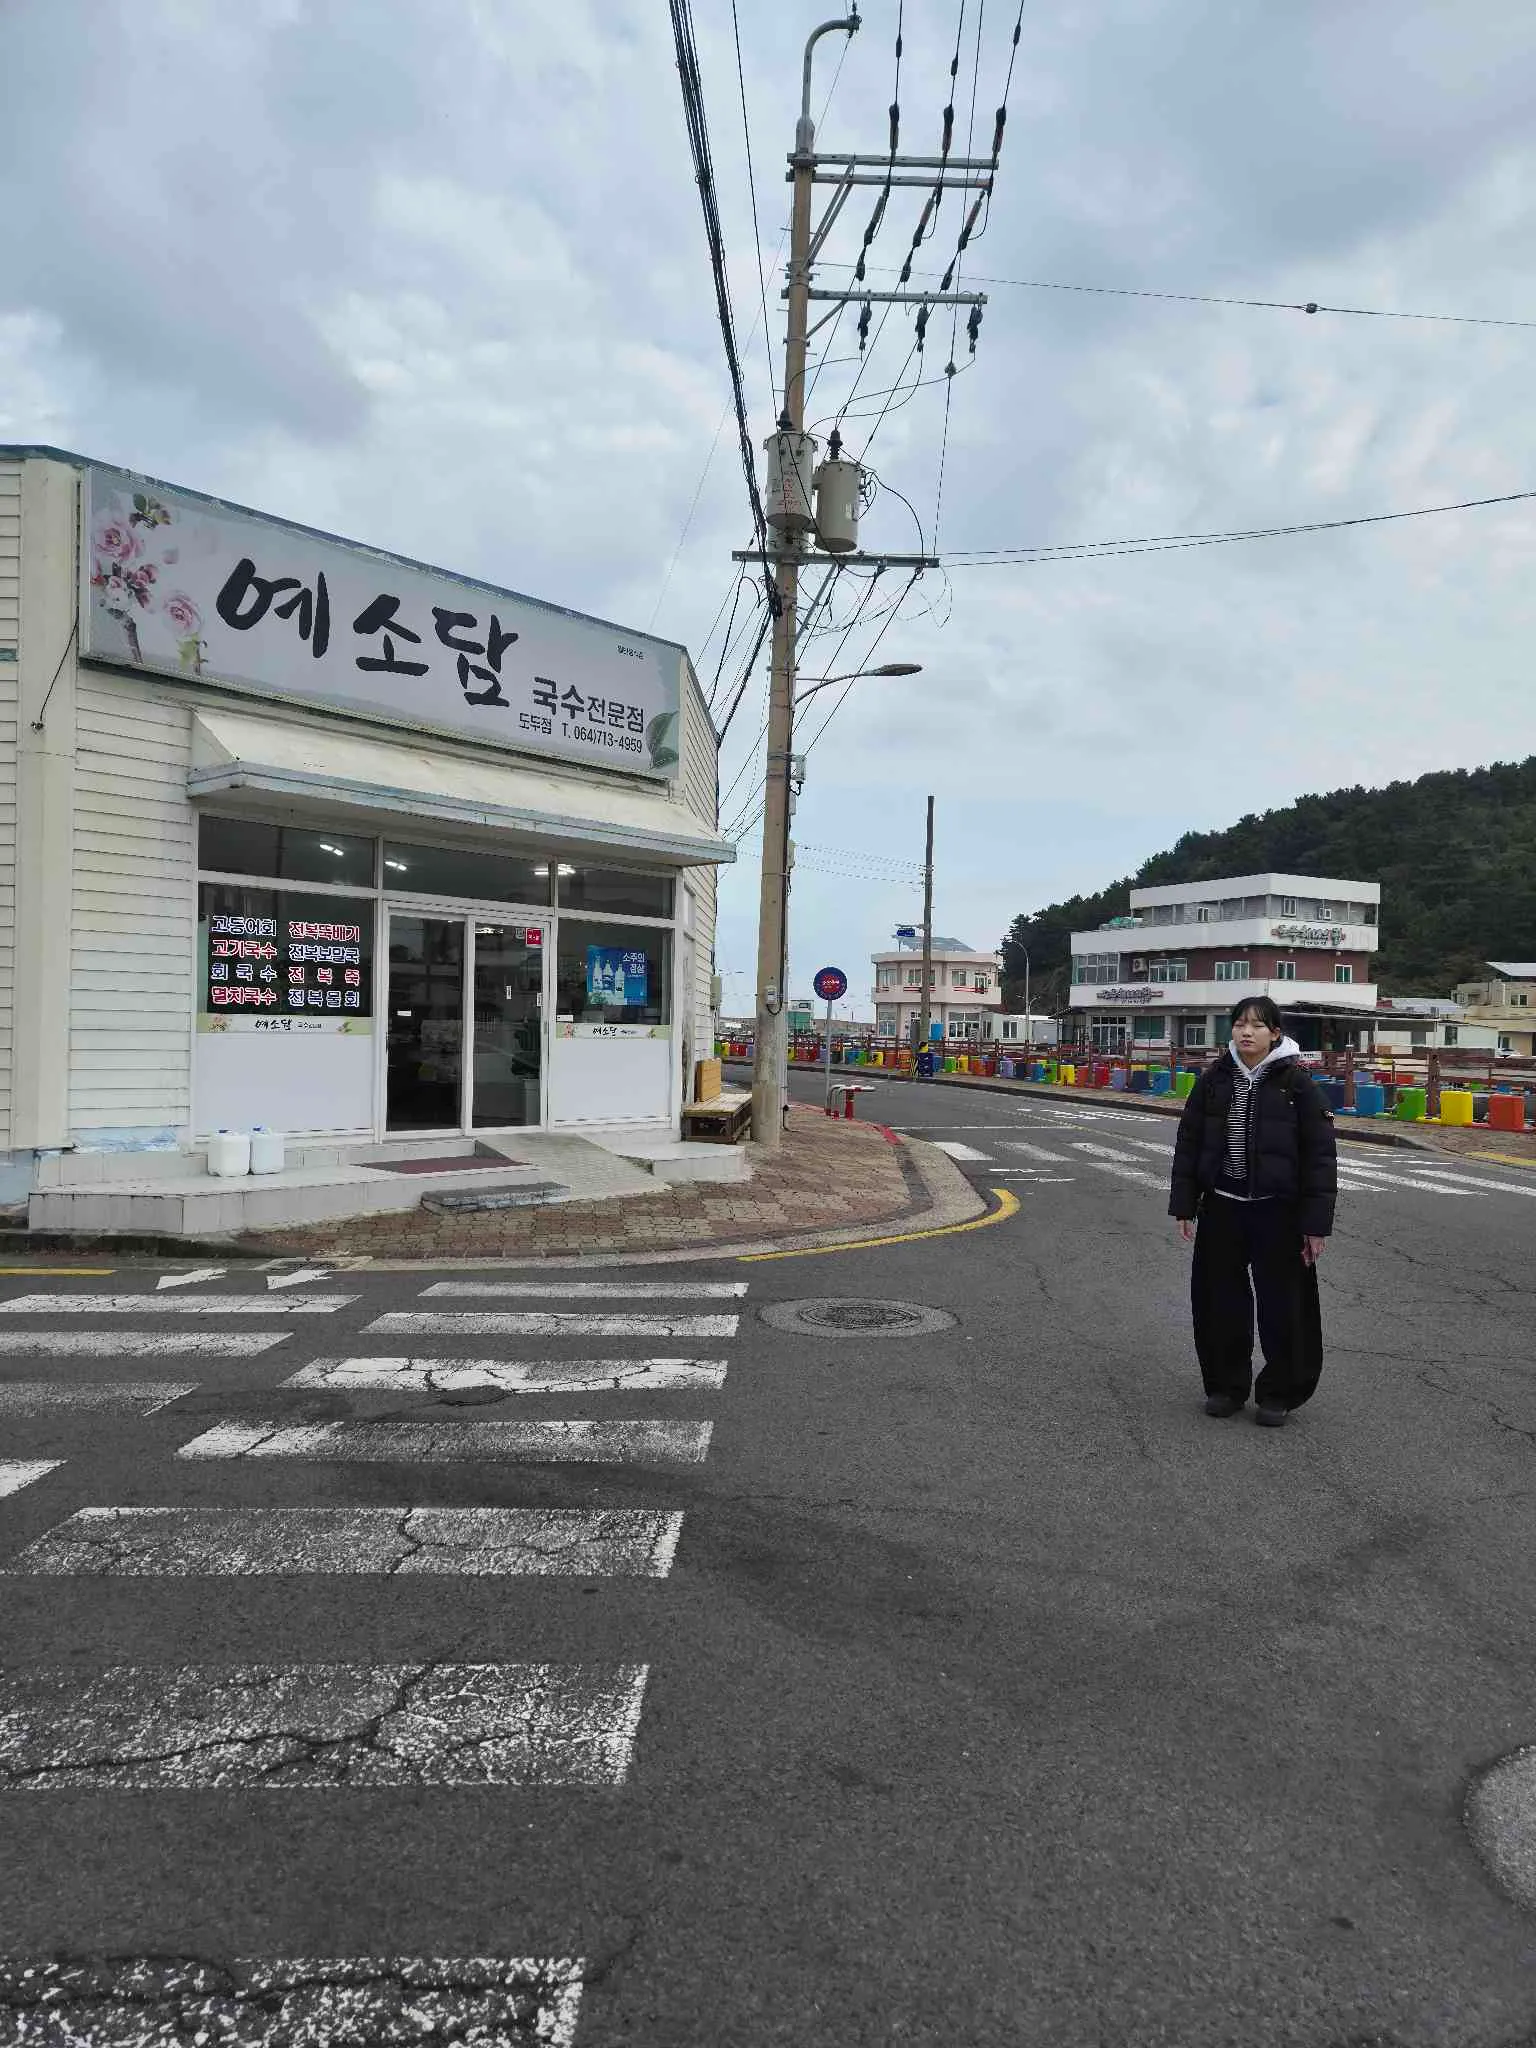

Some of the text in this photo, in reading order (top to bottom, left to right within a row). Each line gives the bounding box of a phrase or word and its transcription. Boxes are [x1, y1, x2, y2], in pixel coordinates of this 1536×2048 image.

[216, 558, 519, 707] 예소담
[532, 676, 645, 733] 국수전문점
[519, 712, 552, 735] 도두점
[211, 915, 277, 936] 고등어회
[288, 921, 360, 942] 전복뚝배기
[211, 939, 277, 959] 고기국수
[288, 943, 360, 964] 전복보말국
[211, 986, 277, 1005] 멸치국수
